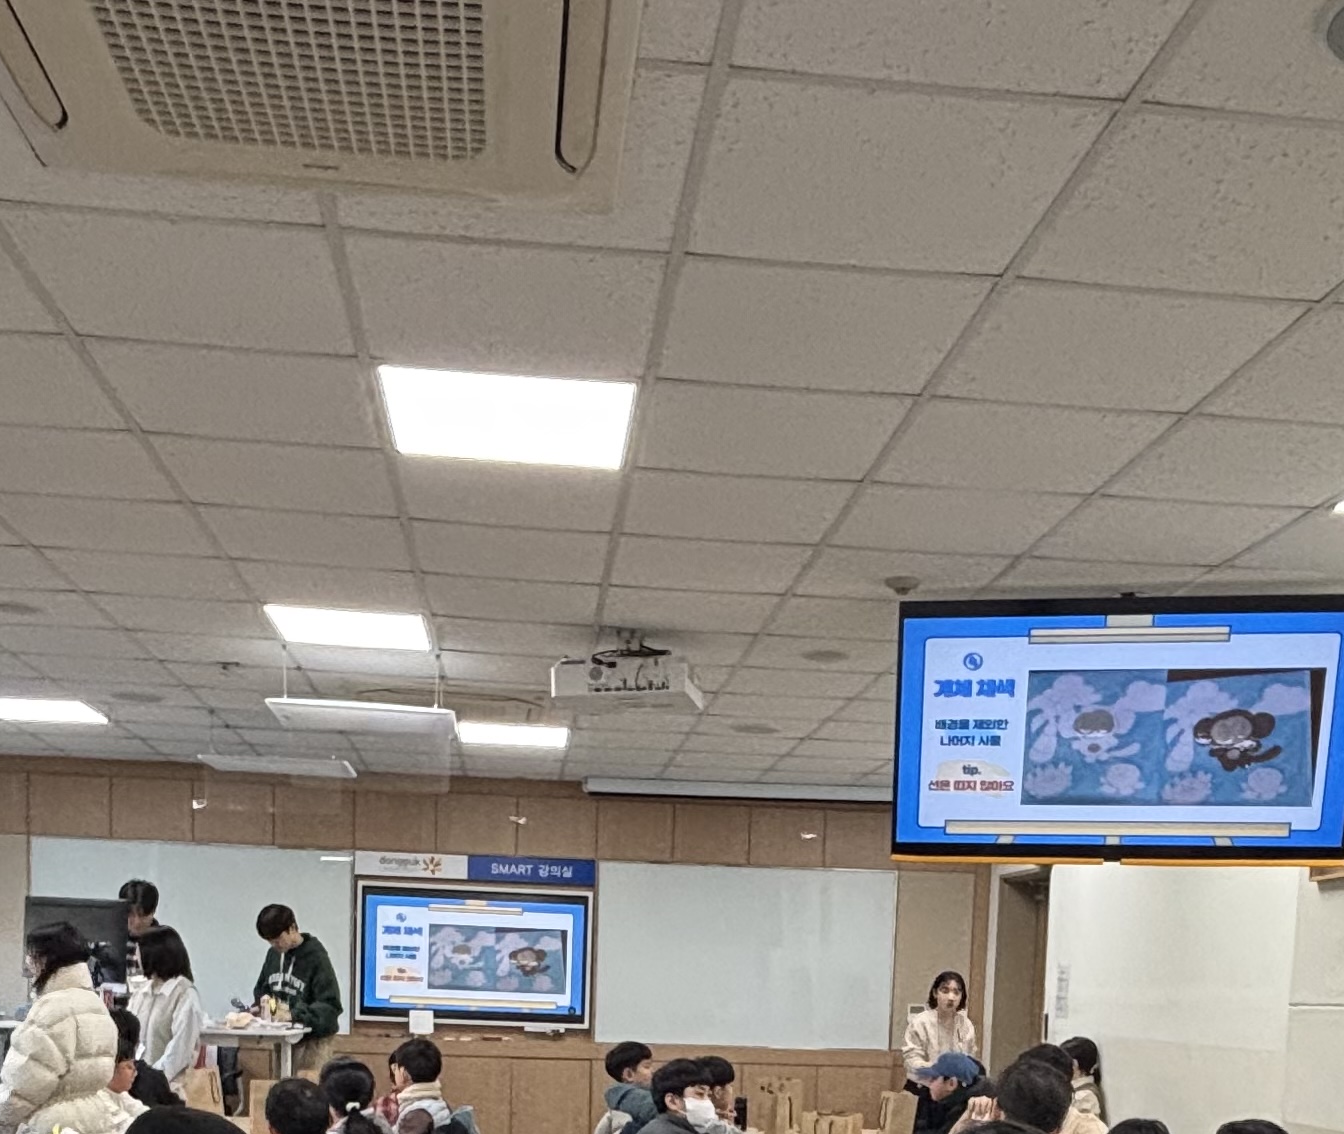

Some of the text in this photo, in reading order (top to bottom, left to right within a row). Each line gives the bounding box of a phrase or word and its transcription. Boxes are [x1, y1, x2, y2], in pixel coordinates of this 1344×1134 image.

[962, 764, 982, 776] tip.
[491, 862, 574, 878] SMART 강의실
